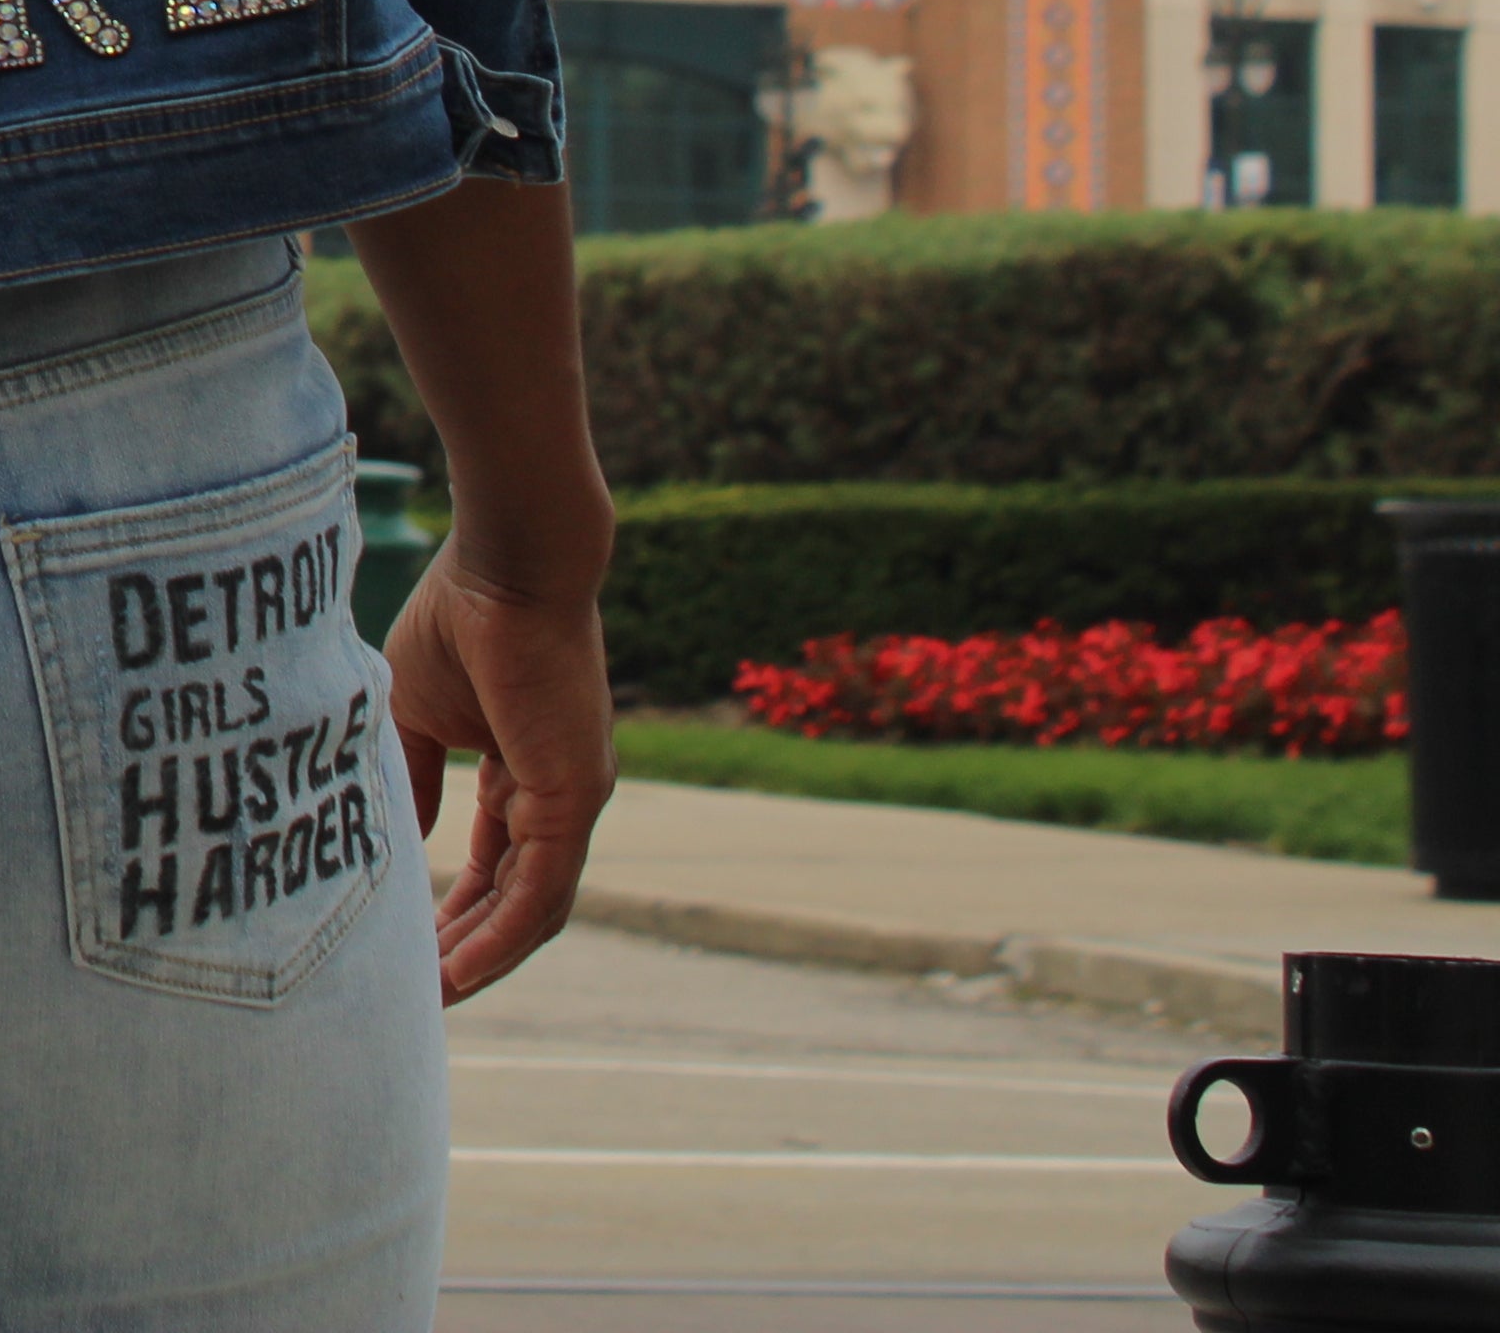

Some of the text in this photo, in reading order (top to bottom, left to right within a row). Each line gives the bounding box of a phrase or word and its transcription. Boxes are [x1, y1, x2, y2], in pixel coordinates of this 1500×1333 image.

[108, 523, 341, 671] DETROIT
[119, 665, 272, 752] GIRLS
[120, 687, 369, 852] HUSTLE
[120, 782, 376, 941] HARDER
